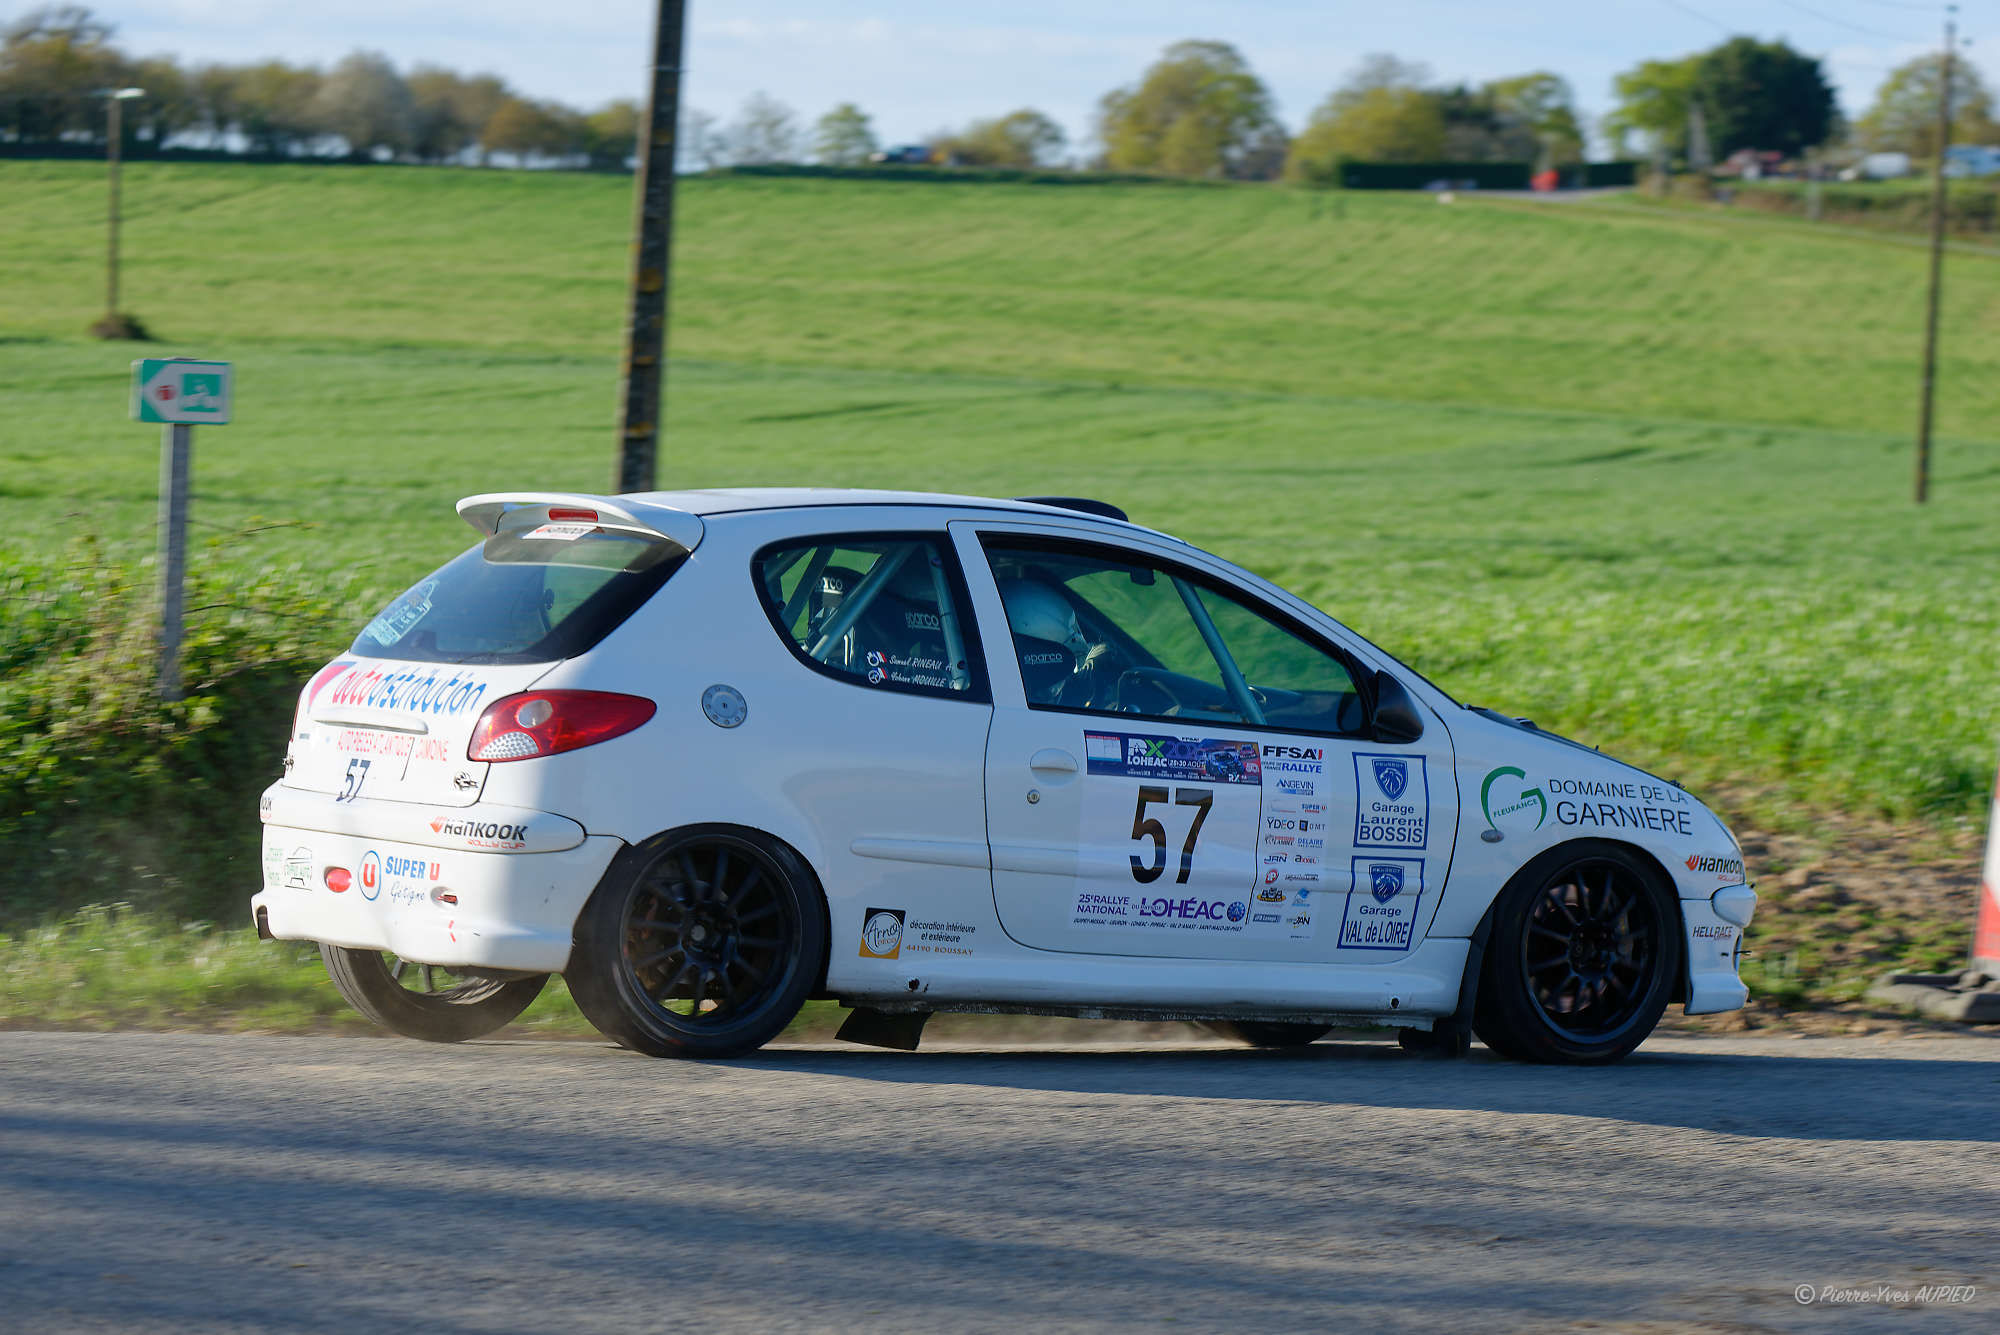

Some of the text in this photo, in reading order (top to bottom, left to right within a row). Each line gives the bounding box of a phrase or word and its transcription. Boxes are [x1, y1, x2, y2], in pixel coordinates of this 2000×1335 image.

[912, 658, 942, 670] RINEAU
[1024, 653, 1063, 665] sparco
[1128, 738, 1166, 758] RX
[1263, 745, 1318, 760] FFSA
[1127, 755, 1168, 768] LOHEAC
[1282, 763, 1322, 773] RALLYE
[336, 758, 371, 803] 57
[1276, 778, 1314, 791] ANGEVIN
[1549, 779, 1689, 805] DOMAINE DE LA
[1371, 801, 1415, 816] Garage
[1493, 797, 1539, 819] FLEURANCE
[1360, 813, 1425, 827] Laurent
[1556, 799, 1693, 836] GARNIÈRE
[1129, 785, 1213, 885] 57
[1360, 825, 1424, 843] BOSSIS
[363, 862, 376, 888] U
[385, 856, 441, 881] SUPER U
[1094, 895, 1130, 906] RALLYE
[1076, 905, 1128, 916] NATIONAL
[1140, 897, 1226, 920] LOHÉAC
[1360, 905, 1402, 918] Garage
[909, 919, 976, 934] décoration intérieure
[1345, 920, 1410, 944] VAL de LOIRE
[920, 931, 961, 943] et extérieure
[934, 946, 974, 956] BOUSSAY
